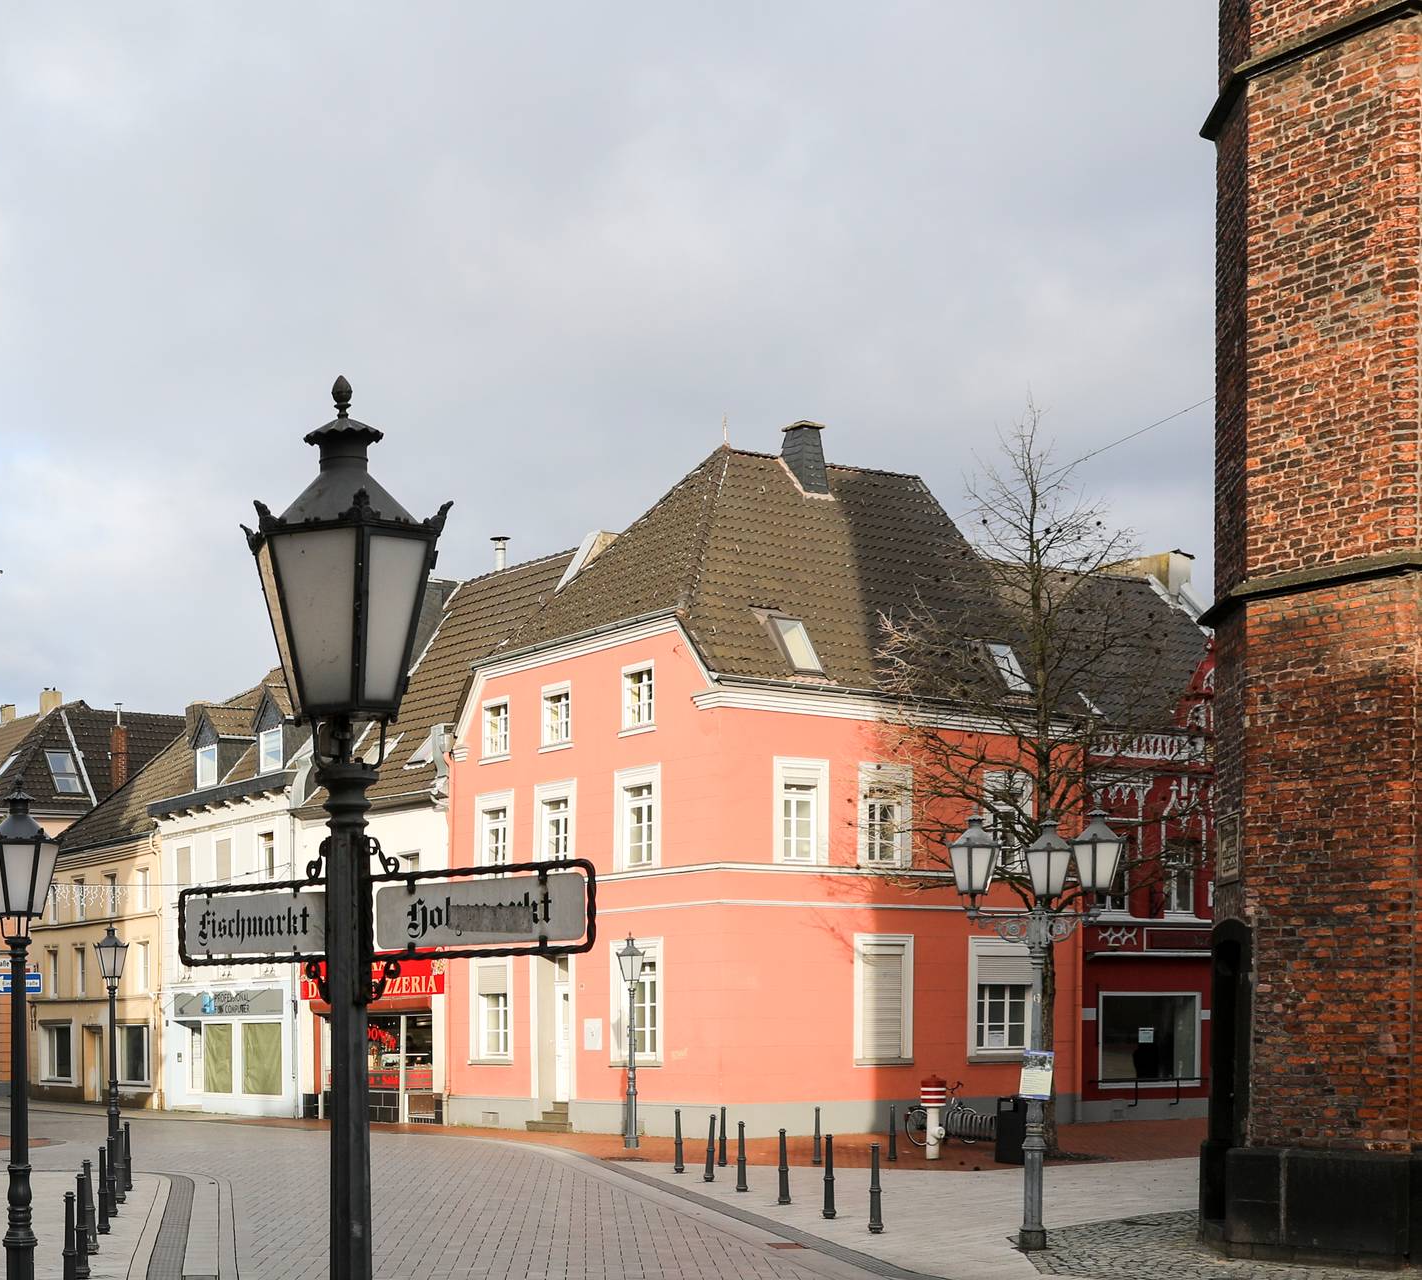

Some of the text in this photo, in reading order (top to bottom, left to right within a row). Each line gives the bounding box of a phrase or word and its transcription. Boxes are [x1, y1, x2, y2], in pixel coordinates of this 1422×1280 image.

[198, 906, 310, 946] Fischmarkt
[407, 890, 552, 939] Holkt
[224, 1004, 250, 1014] COMPUTER
